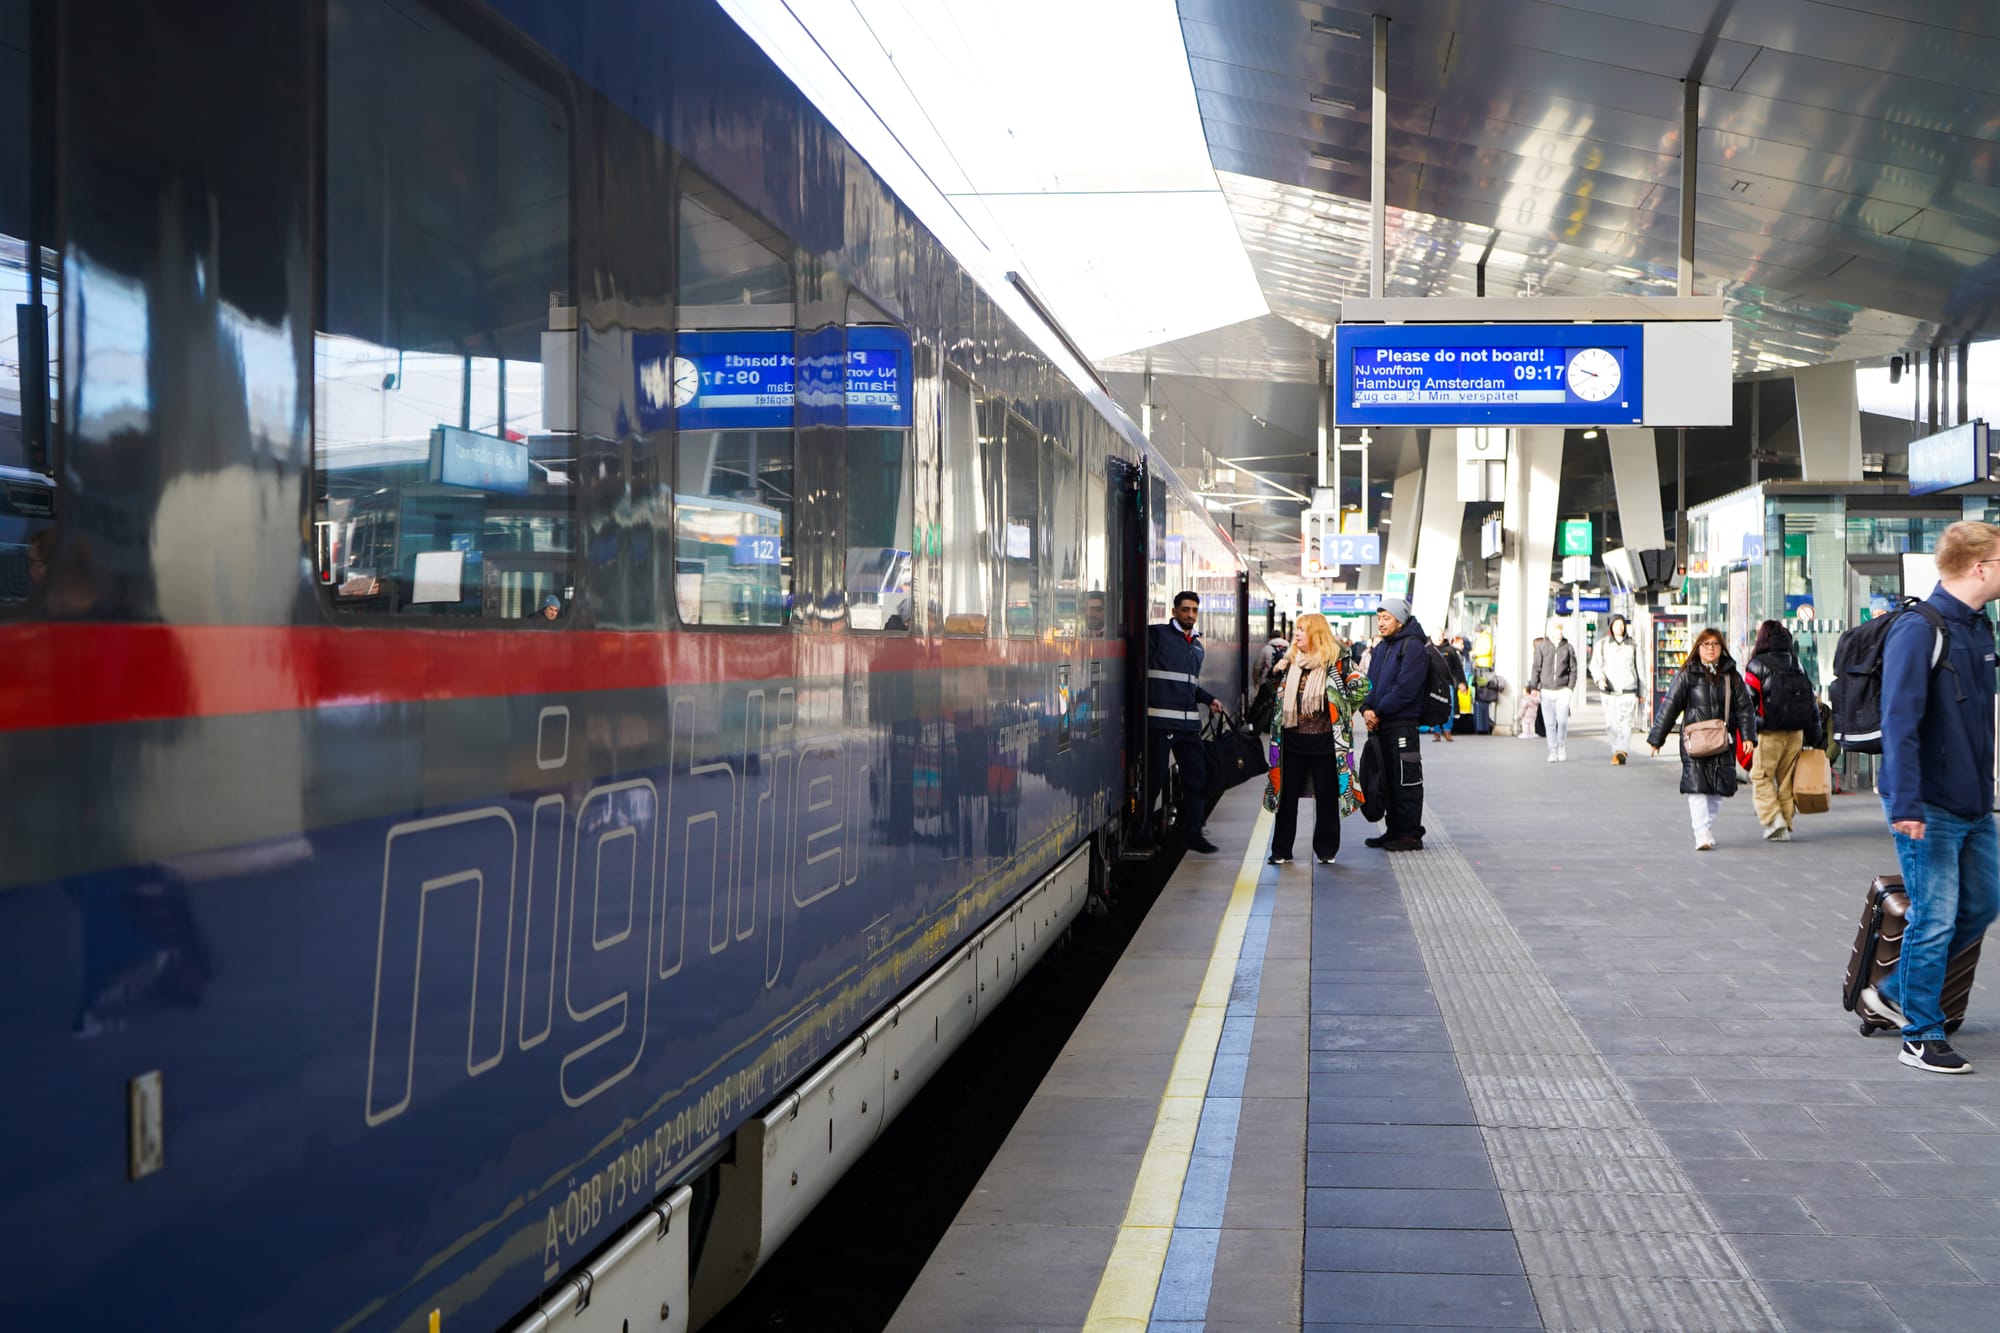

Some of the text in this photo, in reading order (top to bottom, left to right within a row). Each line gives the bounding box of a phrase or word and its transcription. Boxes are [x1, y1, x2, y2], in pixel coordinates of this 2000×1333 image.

[1376, 348, 1545, 362] Please do not board!
[1355, 365, 1565, 380] NJ von/from 09:17
[1356, 377, 1505, 392] Hamburg Amsterdam
[1355, 391, 1378, 403] Zug
[1408, 391, 1421, 401] 21
[1428, 391, 1454, 401] Min.
[1329, 540, 1374, 560] 12 c
[365, 681, 869, 1128] nightjet
[544, 1063, 765, 1266] A-ÖBB 73 81 52-91 408-6 Bcmz
